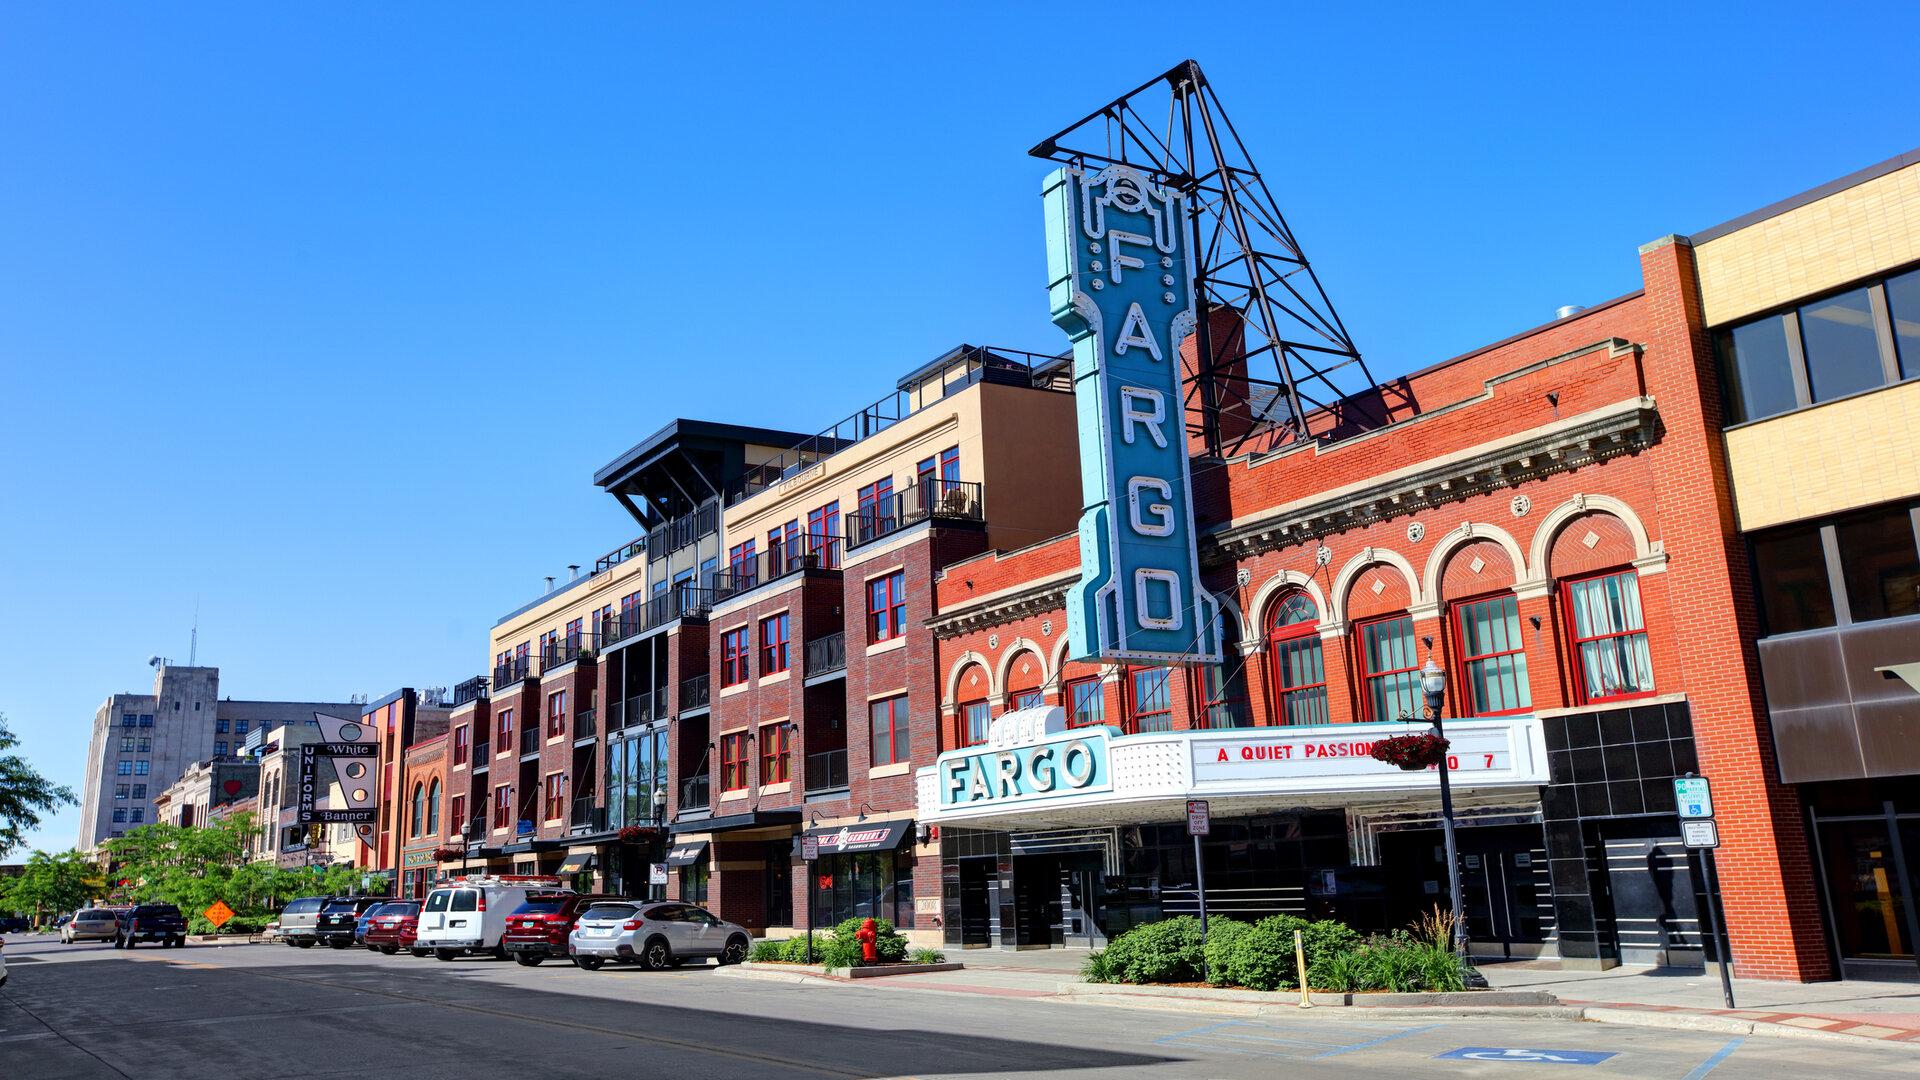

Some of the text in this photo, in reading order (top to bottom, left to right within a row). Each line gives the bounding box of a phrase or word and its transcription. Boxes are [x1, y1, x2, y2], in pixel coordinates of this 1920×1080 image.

[1107, 229, 1183, 631] FARGO
[327, 744, 369, 756] White
[1217, 747, 1229, 761] A
[1241, 745, 1293, 760] QUIET
[1483, 754, 1494, 769] 7
[946, 739, 1097, 804] FARGO
[301, 746, 314, 821] UNIFORMS
[320, 810, 370, 822] Banner
